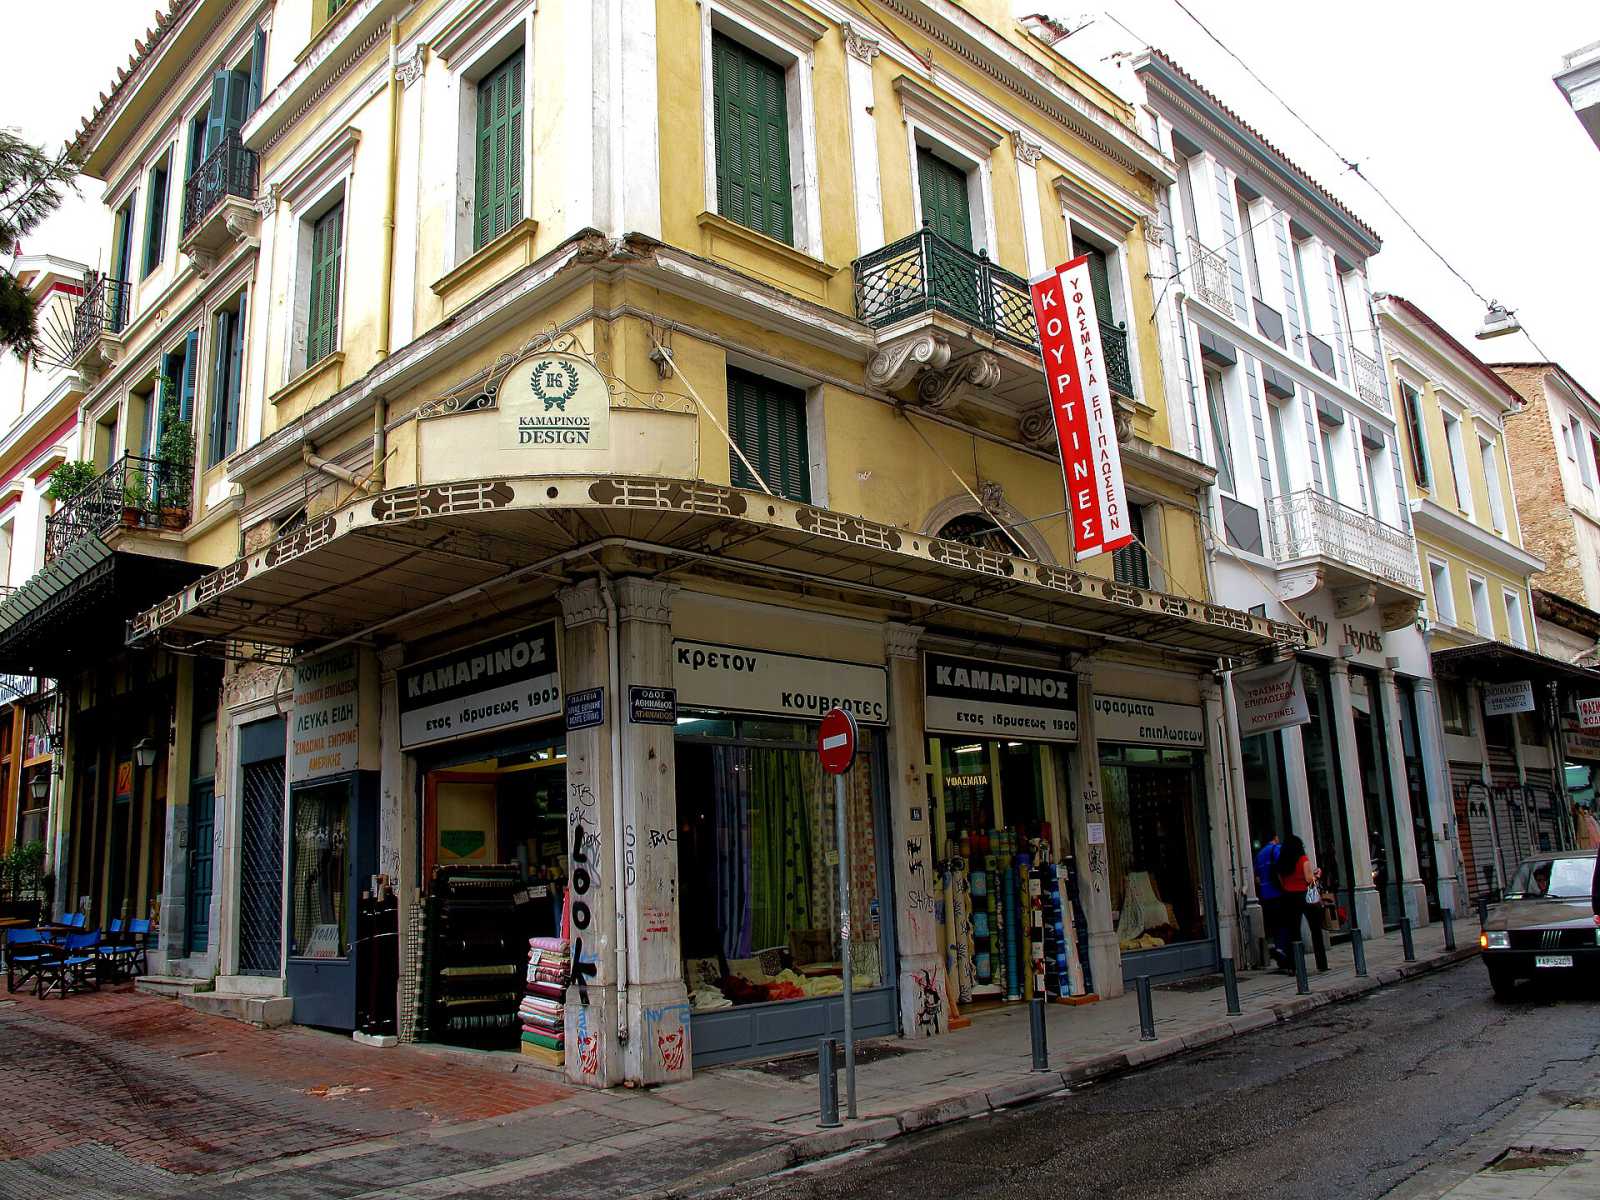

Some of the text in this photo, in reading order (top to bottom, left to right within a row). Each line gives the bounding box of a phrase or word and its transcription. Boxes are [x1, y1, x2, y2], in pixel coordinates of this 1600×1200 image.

[1070, 277, 1119, 531] ΥΦΑΣΜΑΤΑ ΕΠΙΠΛΩΣΕΩΝ
[519, 416, 590, 426] ΚΑΜΑΡΙΝΟΣ
[1041, 289, 1094, 540] ΚΟΥΡΤΙΝΕΣ
[519, 430, 590, 444] DESIGN
[408, 638, 546, 698] ΚΑΜΑΡΙΝΟΣ
[678, 647, 756, 673] κρετον
[936, 665, 1068, 699] ΚΑΜΑΡΙΝΟΣ
[527, 687, 559, 706] 1900
[641, 690, 666, 699] ΟΔΟΣ
[297, 704, 353, 732] ΛΕΥΚΑ ΕΙΔΗ
[1094, 699, 1154, 718] υφασματα
[1251, 706, 1296, 723] ΚΟΥΡΤΙΝΕΣ
[1053, 719, 1076, 731] 1900
[1139, 726, 1203, 743] επιπλωσεων
[945, 775, 987, 787] ΥΦΑΣΜΑΤΑ
